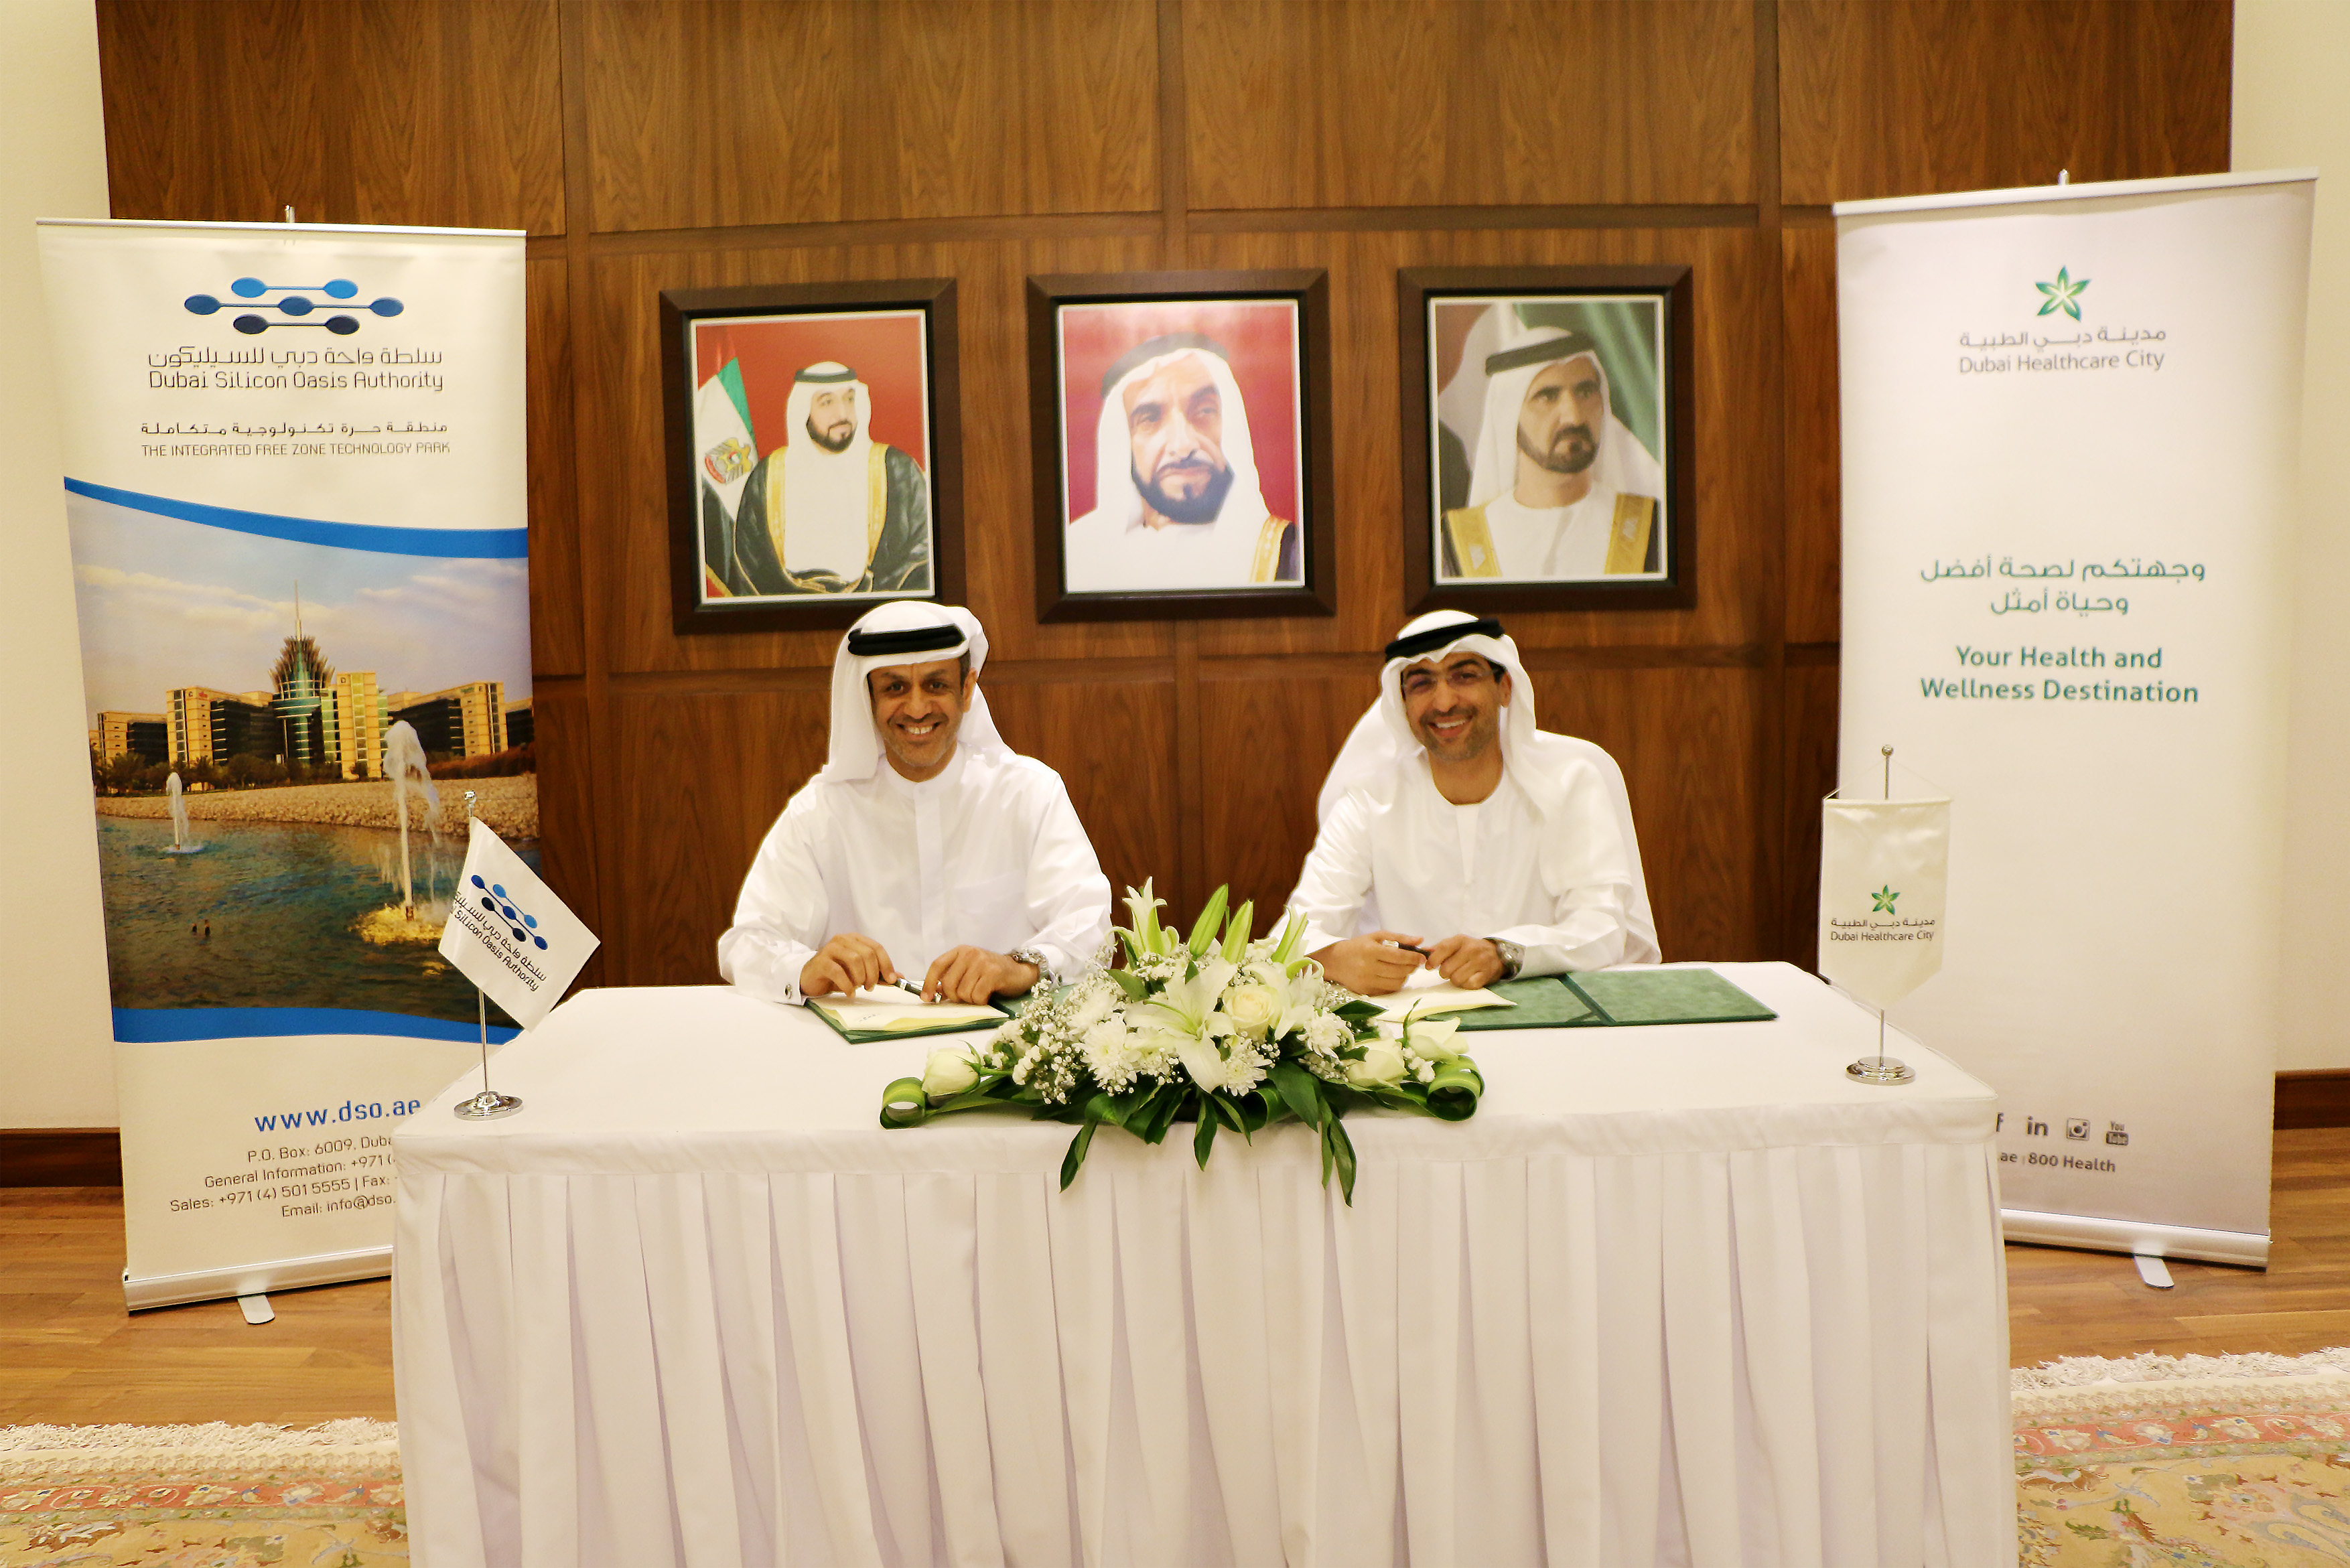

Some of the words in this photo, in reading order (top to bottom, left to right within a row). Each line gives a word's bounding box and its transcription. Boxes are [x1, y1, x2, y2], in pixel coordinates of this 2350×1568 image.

[1959, 332, 2028, 352] الطبية
[2034, 333, 2093, 353] دبي
[2097, 326, 2166, 346] مدينة
[148, 346, 264, 368] للسيليكون
[271, 350, 318, 368] دبي
[325, 347, 374, 364] واحة
[381, 347, 442, 364] سلطة
[1959, 355, 2011, 373] Dubai
[2018, 352, 2120, 372] Healthcare
[2126, 349, 2166, 372] City
[149, 370, 209, 388] Dubai
[215, 370, 287, 388] Silicon
[293, 370, 348, 388] Oasis
[354, 370, 443, 392] Authority
[141, 422, 227, 435] متكاملة
[232, 422, 334, 437] تكنولوجية
[341, 423, 381, 437] حرة
[387, 421, 447, 433] منطقة
[141, 445, 167, 456] THE
[171, 444, 252, 456] INTEGRATED
[255, 443, 288, 455] FREE
[292, 443, 326, 455] ZONE
[330, 442, 412, 454] TECHNOLOGY
[416, 441, 451, 453] PARK
[1921, 555, 1992, 582] أفضل
[1999, 557, 2075, 579] لصحة
[2081, 557, 2206, 583] وجهتكم
[1990, 587, 2049, 616] أمثل
[2055, 591, 2130, 617] وحياة
[1955, 645, 2012, 666] Your
[2020, 646, 2105, 667] Health
[2114, 647, 2162, 668] and
[1921, 677, 2035, 699] Wellness
[2043, 679, 2199, 703] Destination
[483, 920, 502, 940] دبي
[1831, 918, 1868, 929] الطبية
[1870, 921, 1900, 931] دبي
[1903, 918, 1936, 928] مدينة
[1830, 931, 1858, 941] Dubai
[1861, 932, 1914, 942] Healthcare
[1917, 930, 1935, 942] City
[454, 910, 483, 939] Silicon
[482, 935, 504, 959] Oasis
[502, 956, 539, 992] Authority
[500, 938, 521, 959] واحة
[521, 956, 547, 981] سلطة
[255, 1099, 421, 1132] www.dso.ae
[248, 1149, 275, 1163] P.O.
[279, 1147, 310, 1159] Box:
[2028, 1152, 2059, 1167] 800
[2063, 1155, 2116, 1173] Health
[204, 1170, 259, 1188] General
[263, 1162, 346, 1181] Information:
[351, 1154, 383, 1168] +971
[169, 1198, 214, 1212] Sales:
[219, 1190, 253, 1205] +971
[257, 1186, 277, 1202] (4)
[281, 1184, 308, 1198] 501
[312, 1178, 351, 1194] 5555
[362, 1175, 390, 1188] Fax:
[281, 1202, 322, 1218] Email:
